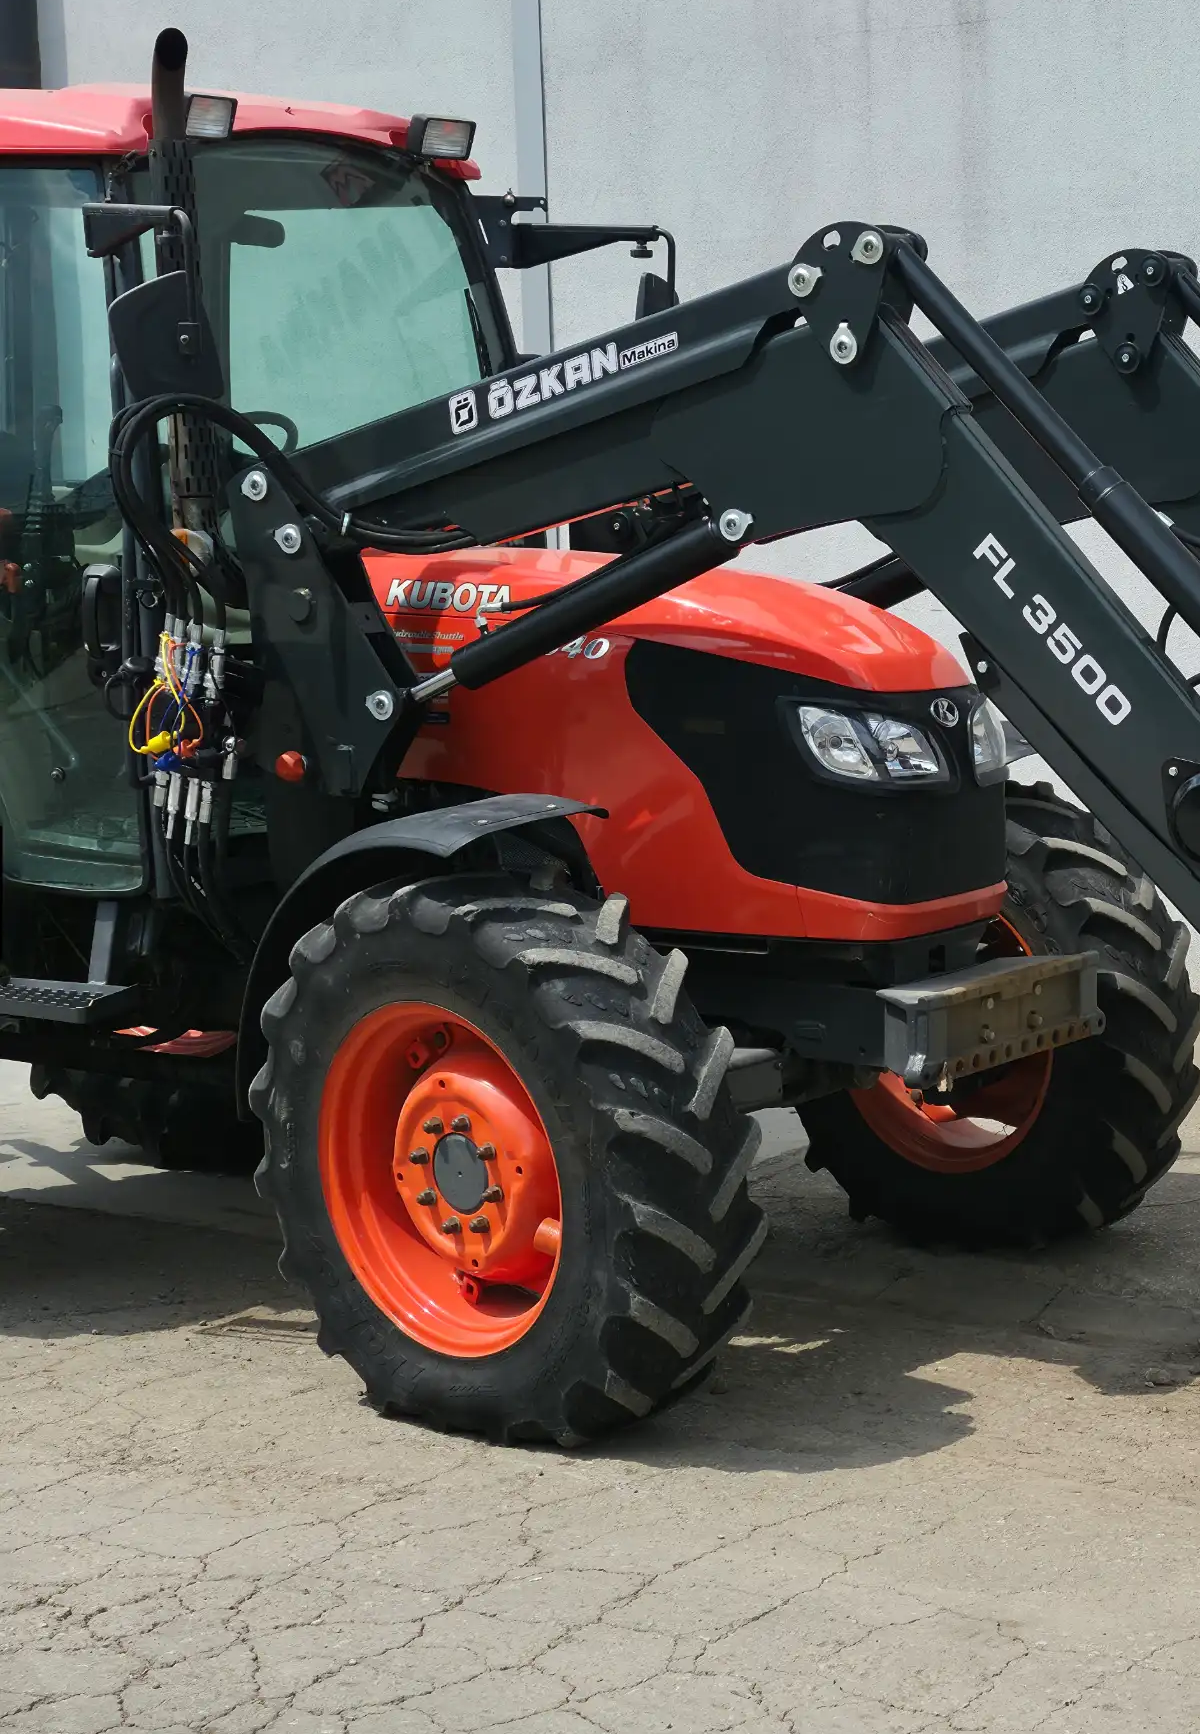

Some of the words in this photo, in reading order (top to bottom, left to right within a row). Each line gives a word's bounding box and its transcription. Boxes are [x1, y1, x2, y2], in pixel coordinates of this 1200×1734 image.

[487, 341, 619, 419] ÖZKAN
[621, 337, 676, 367] Makina
[385, 578, 512, 614] KUBOTA
[973, 533, 1016, 599] FL
[1022, 594, 1132, 726] 3500
